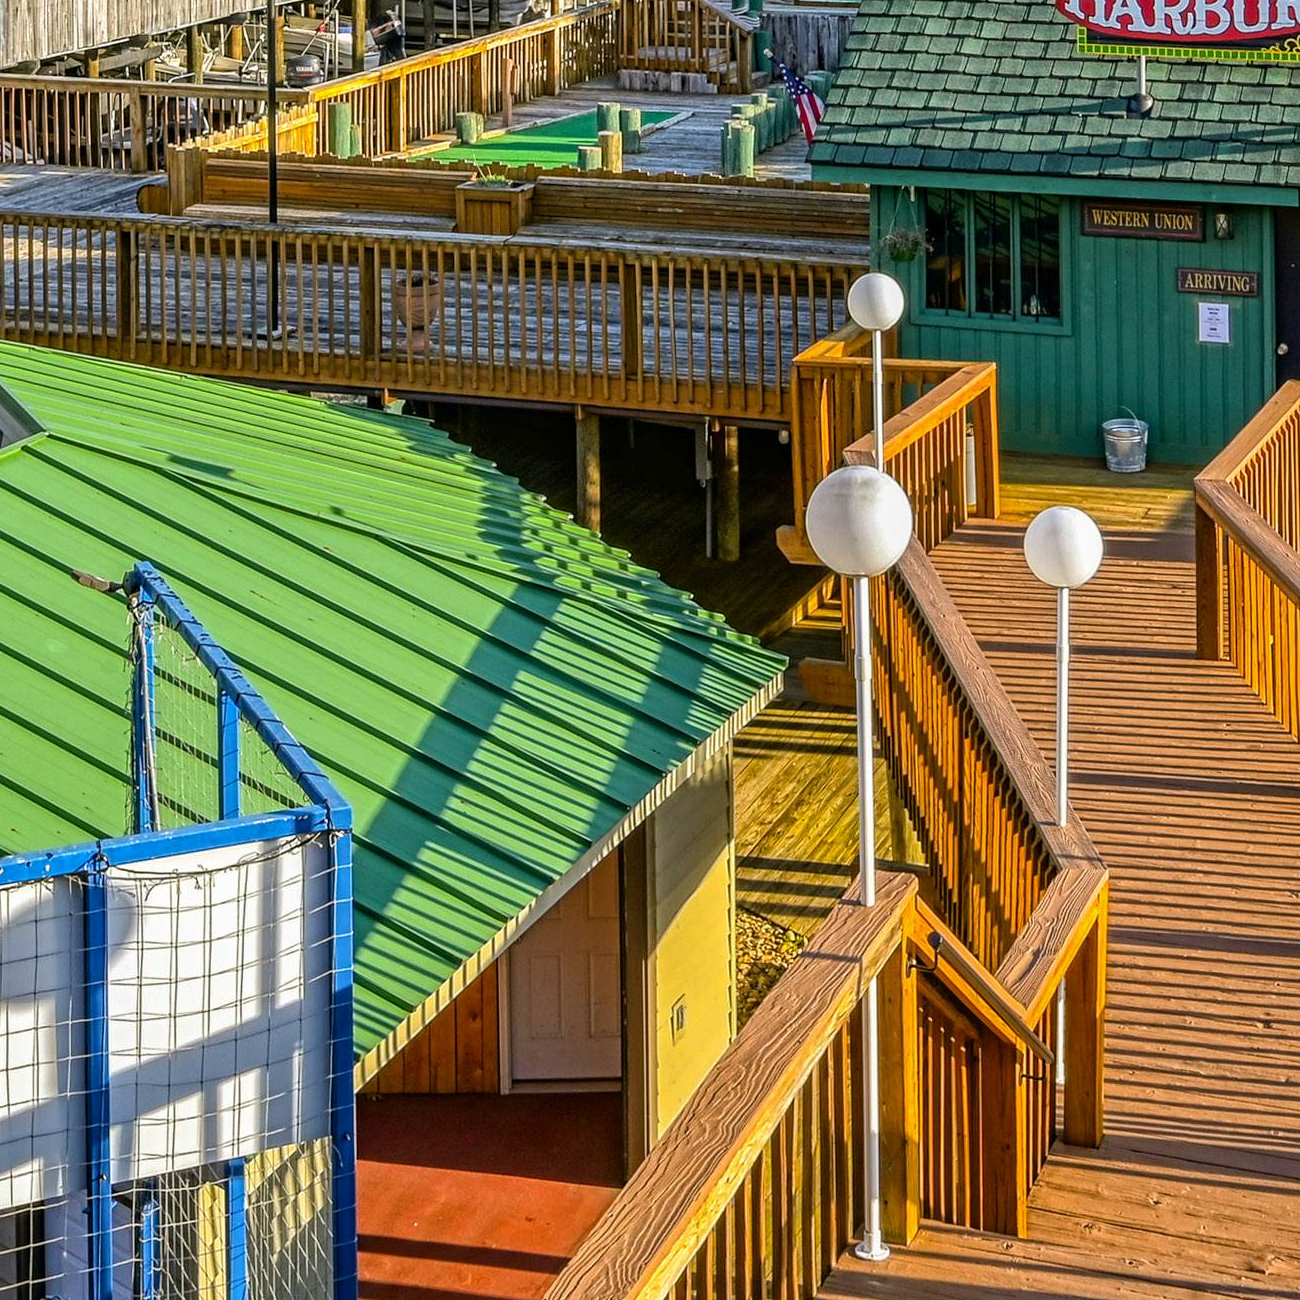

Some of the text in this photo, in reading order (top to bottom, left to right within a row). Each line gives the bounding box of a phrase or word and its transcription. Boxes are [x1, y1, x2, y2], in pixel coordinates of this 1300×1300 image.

[1092, 209, 1194, 231] WESTERN UNION
[1184, 272, 1250, 292] ARRIVING
